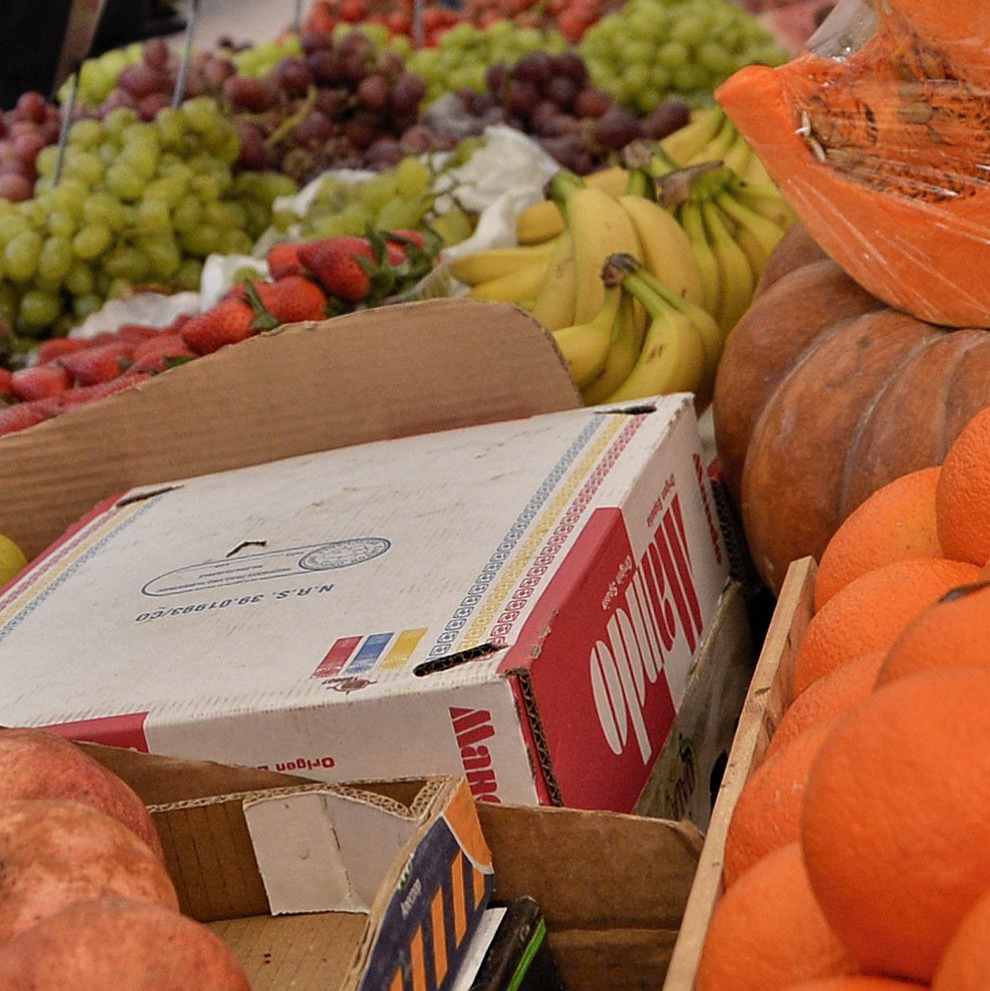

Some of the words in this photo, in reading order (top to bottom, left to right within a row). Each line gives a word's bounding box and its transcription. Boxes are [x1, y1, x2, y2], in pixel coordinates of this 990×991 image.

[272, 583, 335, 600] N.R.S.
[590, 492, 703, 766] Mando
[276, 756, 336, 772] Origen
